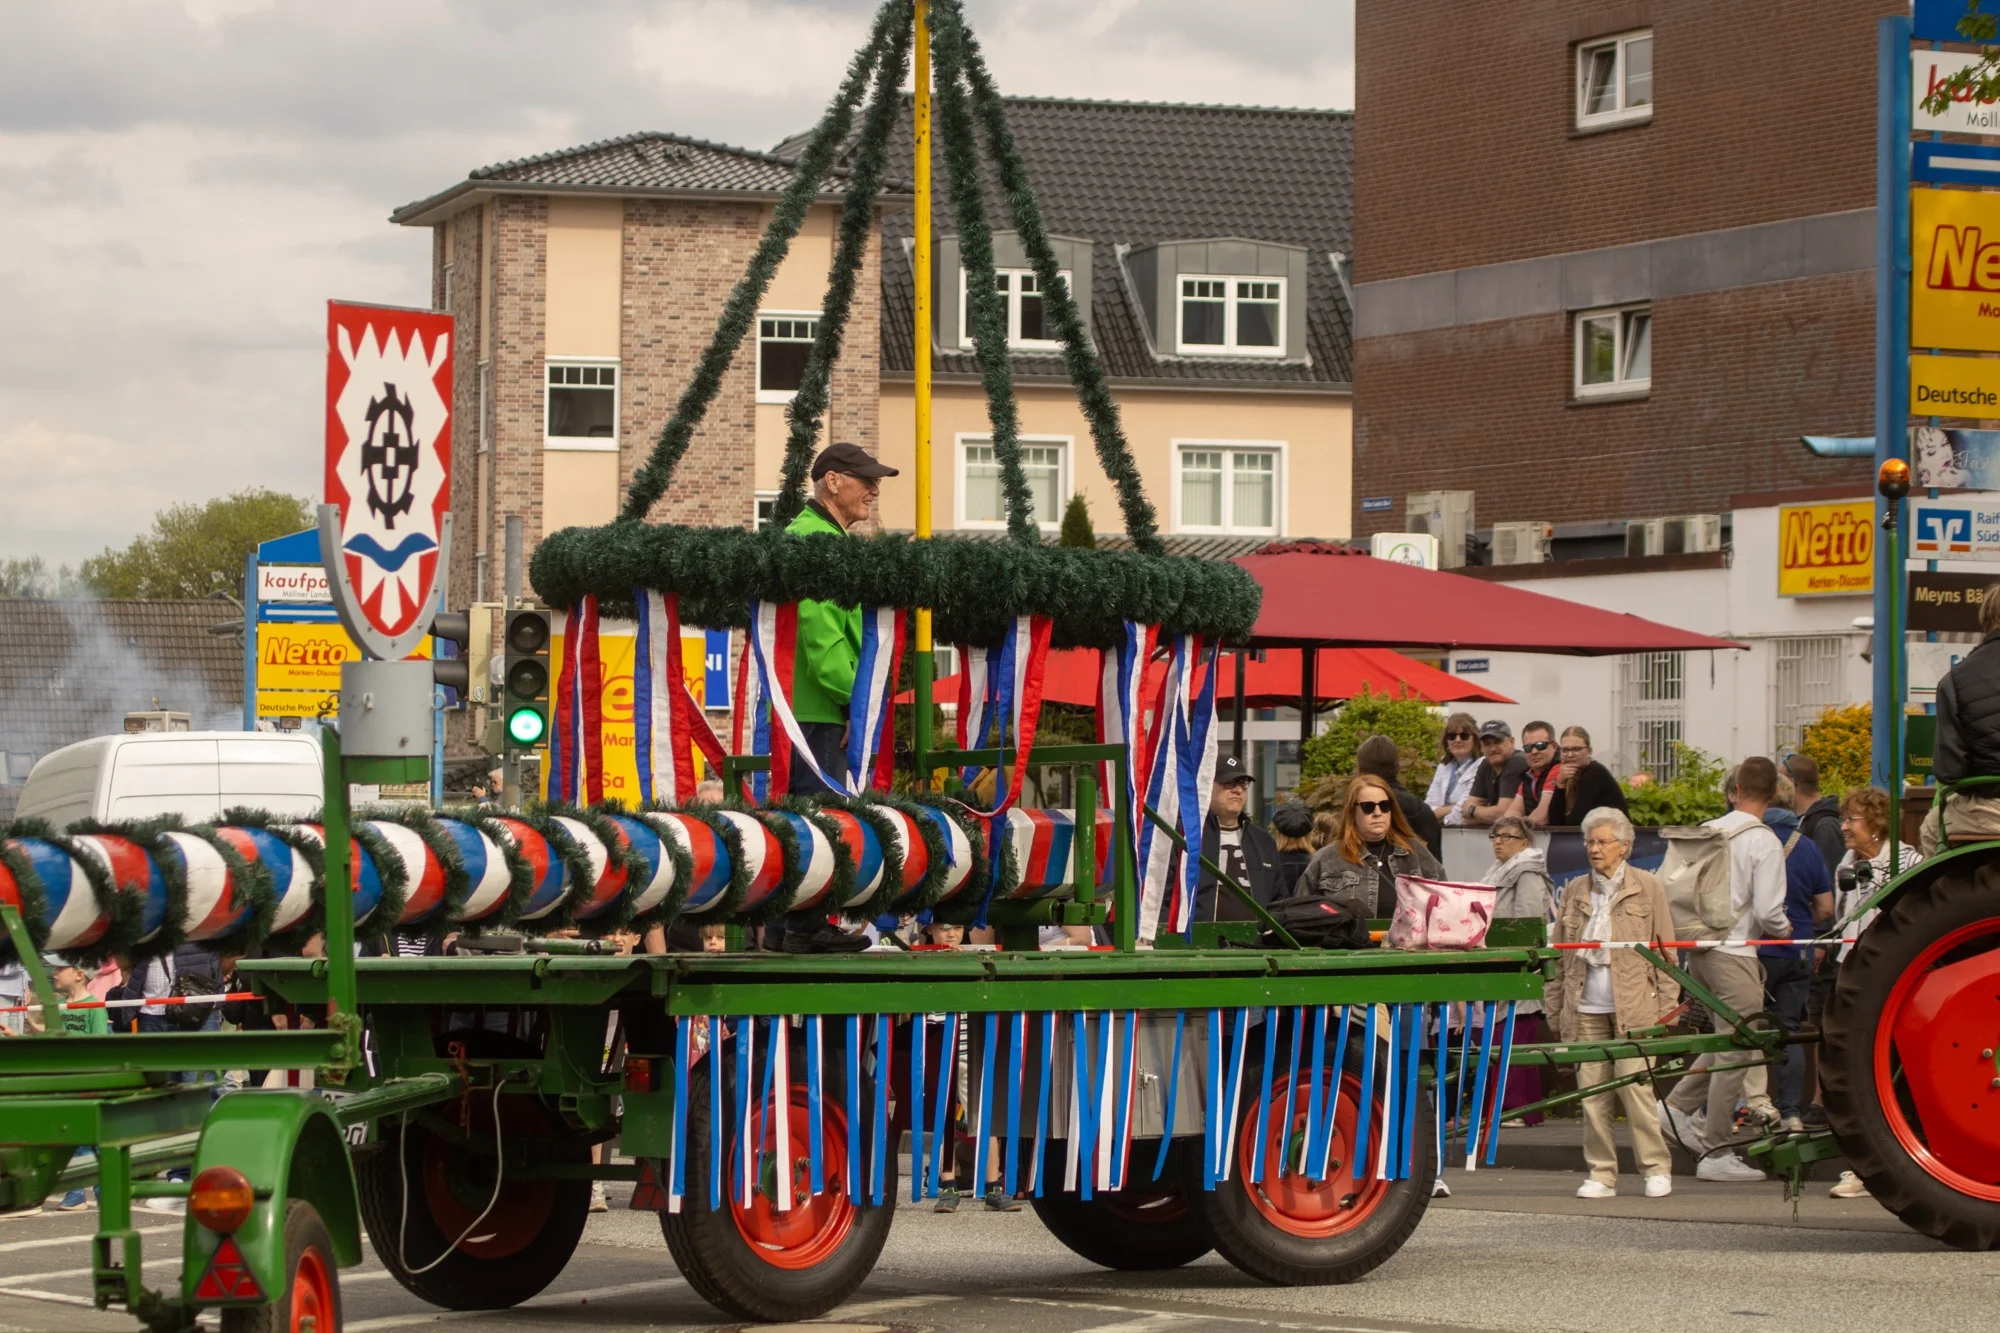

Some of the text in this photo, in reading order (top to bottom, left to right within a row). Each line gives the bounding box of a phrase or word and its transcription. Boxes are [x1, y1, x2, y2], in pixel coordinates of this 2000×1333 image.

[1917, 384, 1998, 406] Deutsche
[1784, 510, 1873, 570] Netto
[265, 572, 329, 592] kaufpa
[282, 590, 308, 598] Möllner
[1915, 586, 1961, 606] Meyns
[264, 636, 348, 666] Netto
[260, 703, 314, 712] Deutsche Post
